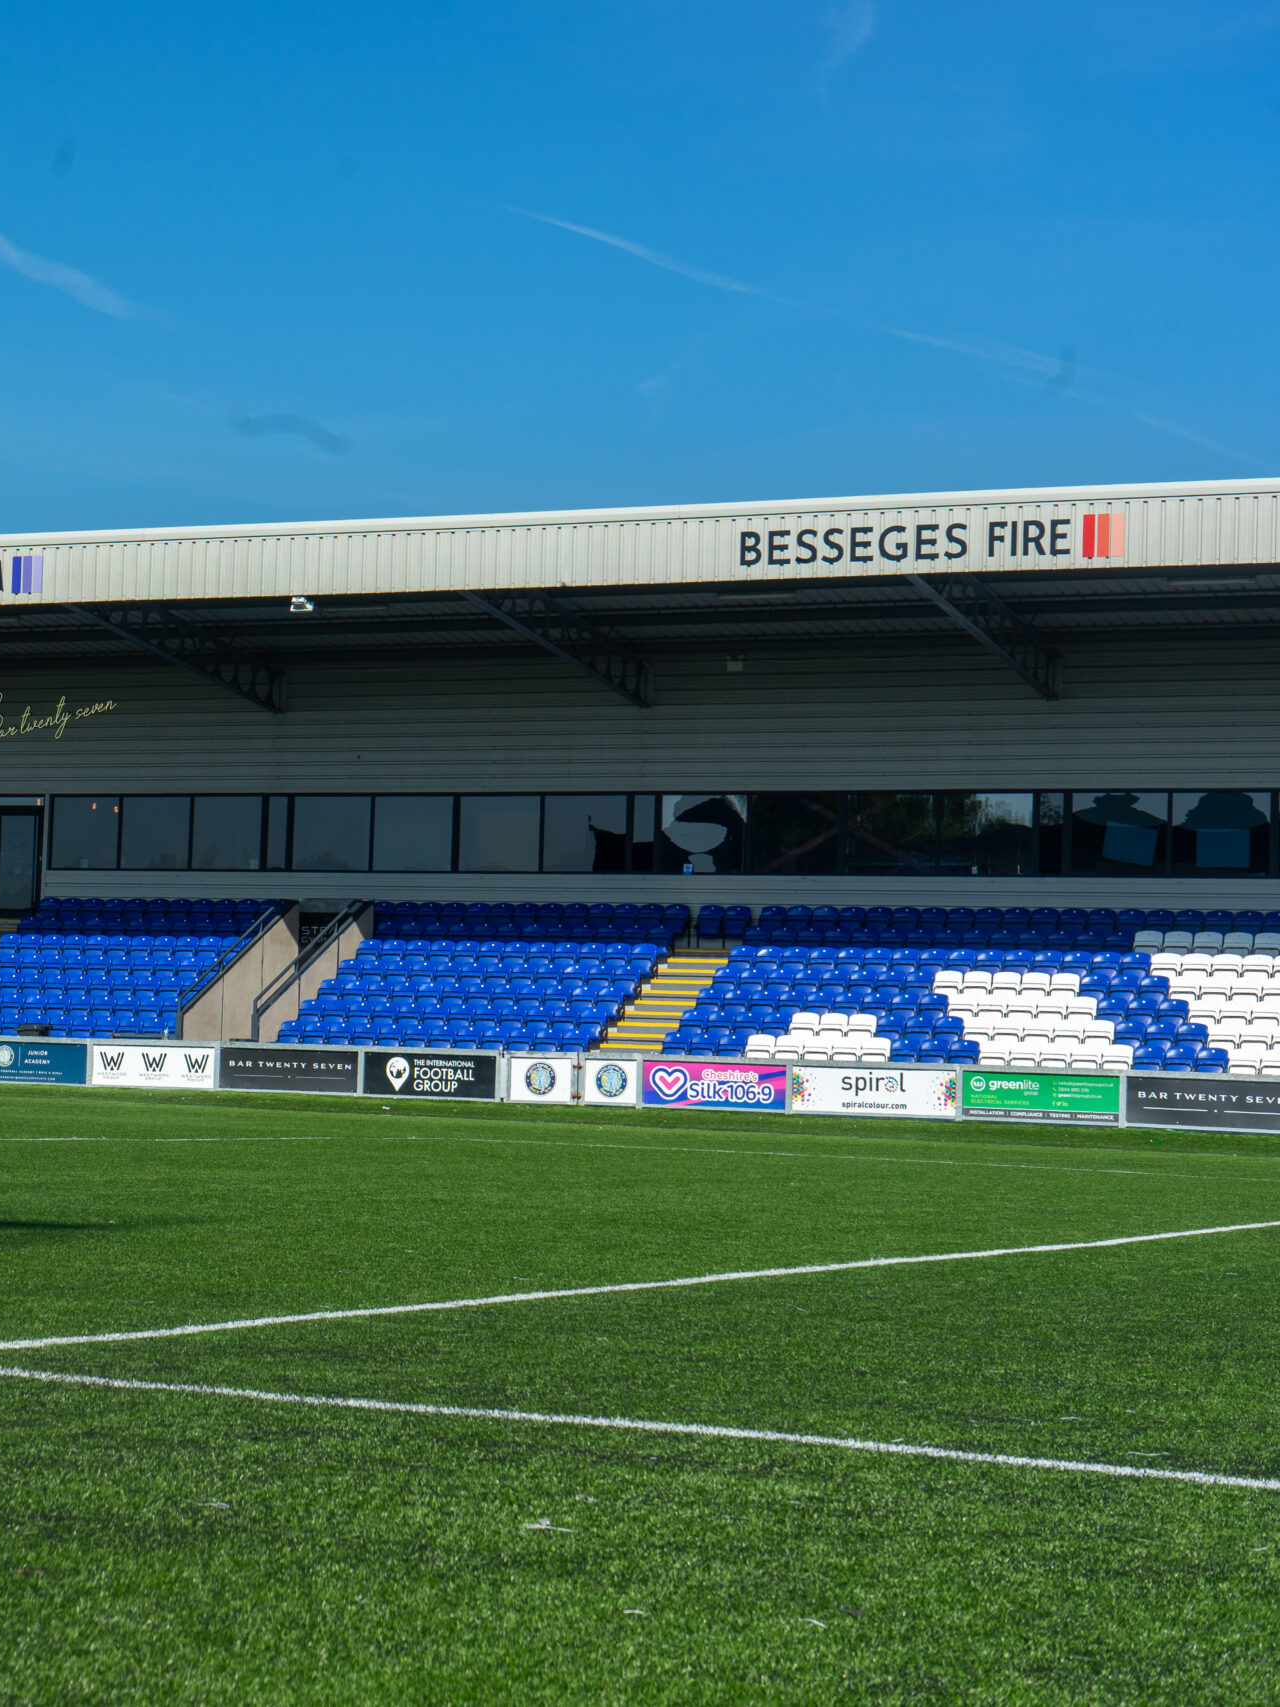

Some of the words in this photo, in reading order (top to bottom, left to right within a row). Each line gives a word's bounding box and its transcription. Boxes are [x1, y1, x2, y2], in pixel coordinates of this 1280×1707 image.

[739, 522, 967, 566] BESSEGES
[988, 518, 1071, 557] FIRE
[20, 695, 71, 740] twenty
[75, 700, 117, 720] seven
[258, 1061, 307, 1069] TWENTY
[312, 1062, 352, 1070] SEVEN
[414, 1067, 475, 1081] FOOTBALL
[703, 1070, 758, 1081] Cheshire's
[413, 1079, 458, 1092] GROUP
[688, 1082, 724, 1100] Silk
[989, 1080, 1040, 1090] greenlite
[1137, 1091, 1168, 1100] BAR
[1174, 1093, 1239, 1102] TWENTY
[842, 1101, 907, 1109] spiralcolour.com
